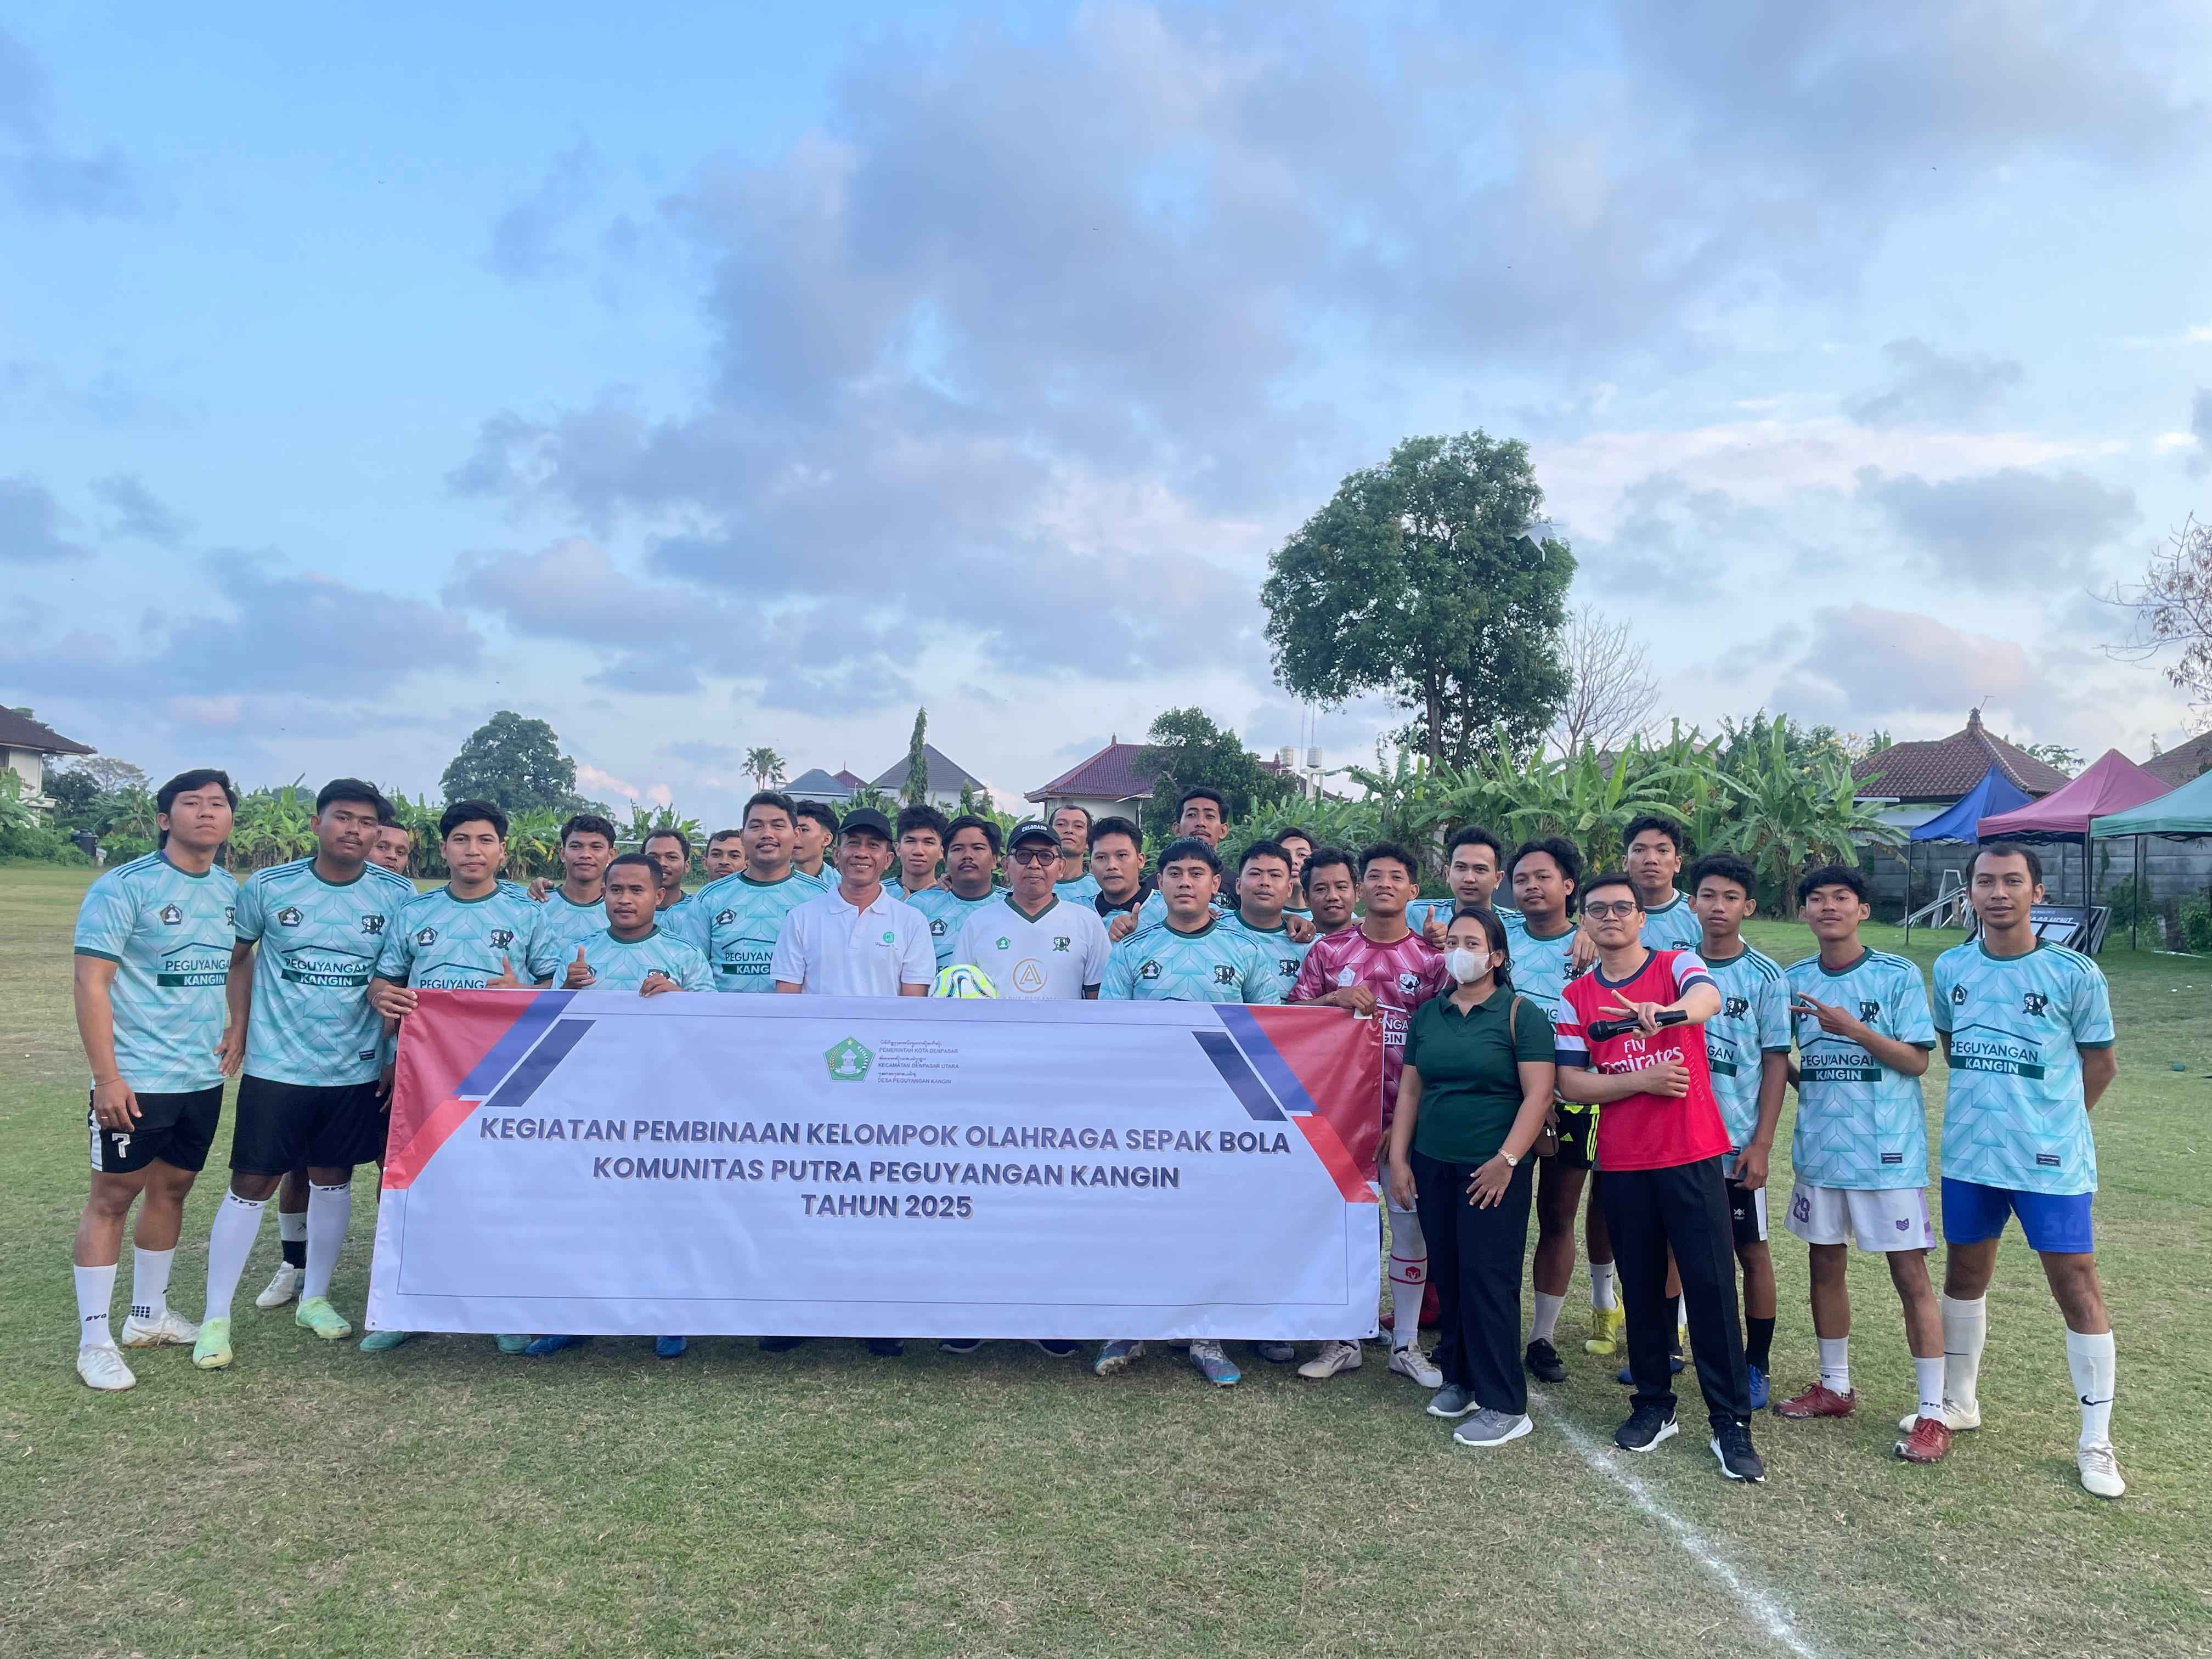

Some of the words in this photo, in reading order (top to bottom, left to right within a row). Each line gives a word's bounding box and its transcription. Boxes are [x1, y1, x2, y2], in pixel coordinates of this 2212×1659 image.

[725, 952, 773, 962] PEGUYAN
[736, 965, 770, 974] KANG
[184, 974, 225, 986] KANGIN
[300, 974, 353, 986] KANGIN
[1623, 1039, 1645, 1053] Fly
[1965, 1058, 2019, 1074] KANGIN
[479, 1118, 626, 1141] KEGIATAN
[633, 1120, 800, 1144] PEMBINAAN
[807, 1123, 959, 1147] KELOMPOK
[966, 1126, 1119, 1150] OLAHRAGA
[1126, 1128, 1214, 1153] SEPAK
[1220, 1131, 1292, 1155] BOLA
[112, 1133, 131, 1158] 7
[593, 1156, 764, 1181] KOMUNITAS
[771, 1160, 863, 1182] PUTRA
[870, 1161, 1063, 1186] PEGUYANGAN
[1070, 1165, 1180, 1188] KANGIN
[800, 1194, 898, 1217] TAHUN
[905, 1194, 972, 1218] 2025
